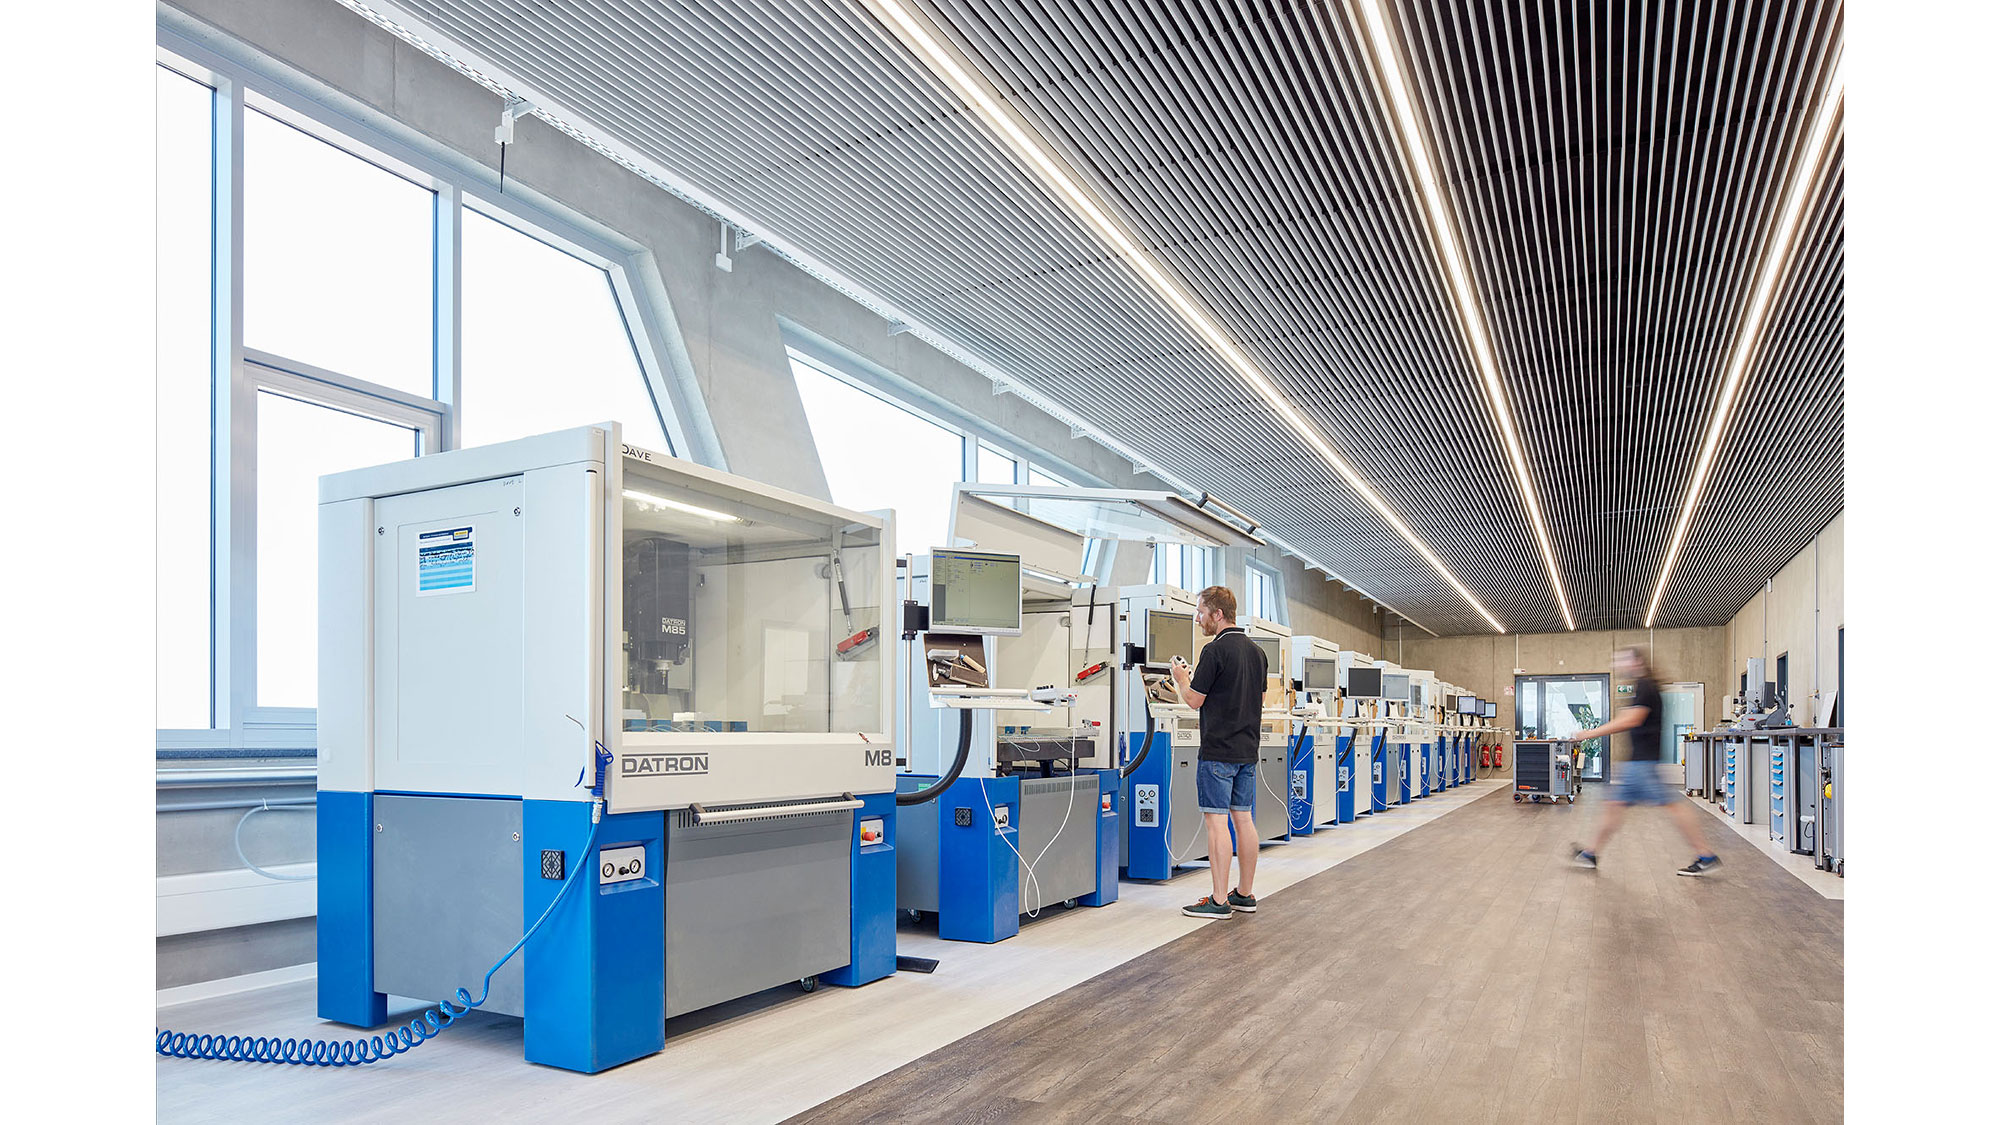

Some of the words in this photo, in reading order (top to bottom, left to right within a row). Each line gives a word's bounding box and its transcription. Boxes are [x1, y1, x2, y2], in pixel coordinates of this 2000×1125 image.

[662, 625, 686, 635] M85
[622, 757, 708, 773] DATRON
[865, 750, 892, 766] M8
